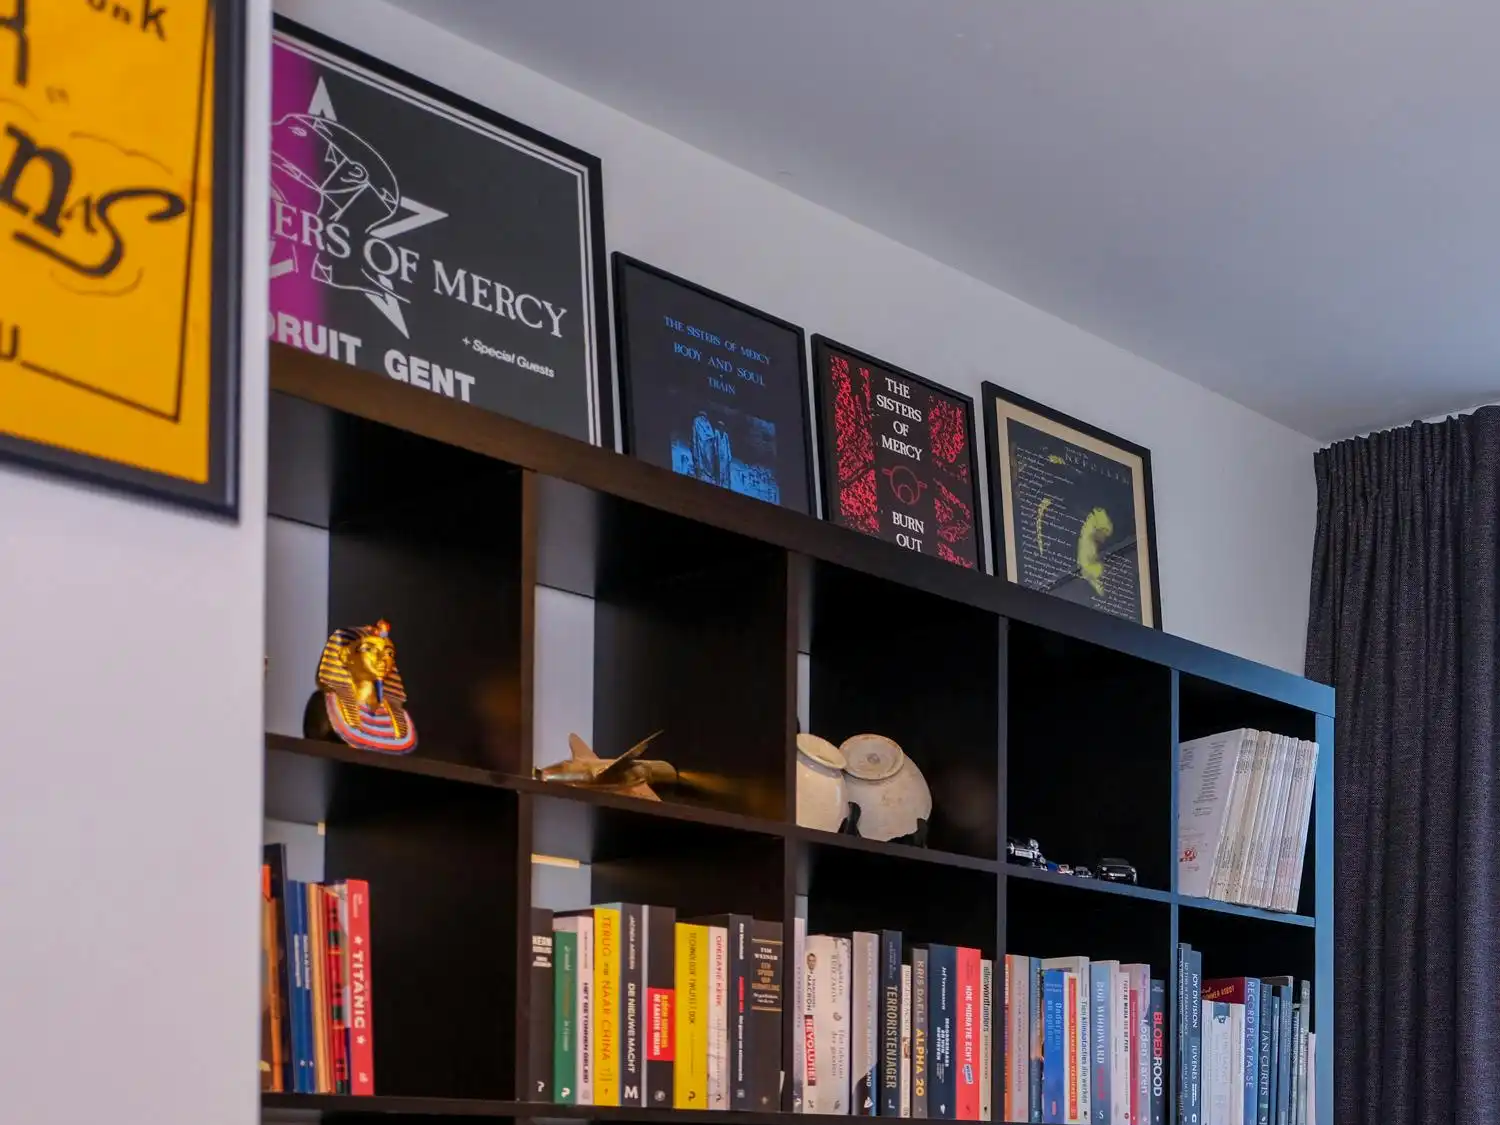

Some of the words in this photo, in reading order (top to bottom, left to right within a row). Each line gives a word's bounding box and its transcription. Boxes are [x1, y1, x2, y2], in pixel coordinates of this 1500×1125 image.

[363, 238, 420, 283] OF
[432, 260, 568, 338] MERCY
[472, 339, 517, 365] Special
[516, 356, 556, 378] Guests
[664, 315, 685, 331] THE
[686, 325, 721, 345] SISTERS
[724, 340, 737, 352] OF
[740, 346, 771, 365] MERCY
[384, 349, 475, 403] GENT
[673, 342, 702, 362] BODY
[707, 357, 733, 373] AND
[737, 367, 766, 386] SOUL
[707, 377, 736, 394] TRAIN
[885, 377, 910, 399] THE
[876, 394, 922, 422] SISTERS
[881, 435, 923, 461] MERCY
[893, 420, 909, 437] OF
[892, 511, 924, 534] BURN
[895, 533, 923, 552] OUT
[352, 950, 366, 1029] TITANIC
[1096, 981, 1104, 1003] BOB
[1246, 981, 1255, 1024] RECORD
[602, 1019, 612, 1062] CHINA
[885, 986, 898, 1090] TERRORISTENJAGER
[915, 1028, 924, 1074] ALPHA
[1096, 1006, 1105, 1064] WOODWARD
[1153, 1011, 1162, 1097] BLOEDROOD
[1261, 1030, 1270, 1051] IAN
[627, 1036, 635, 1074] MACHT
[915, 1078, 924, 1097] 20
[1261, 1056, 1270, 1096] CURTIS
